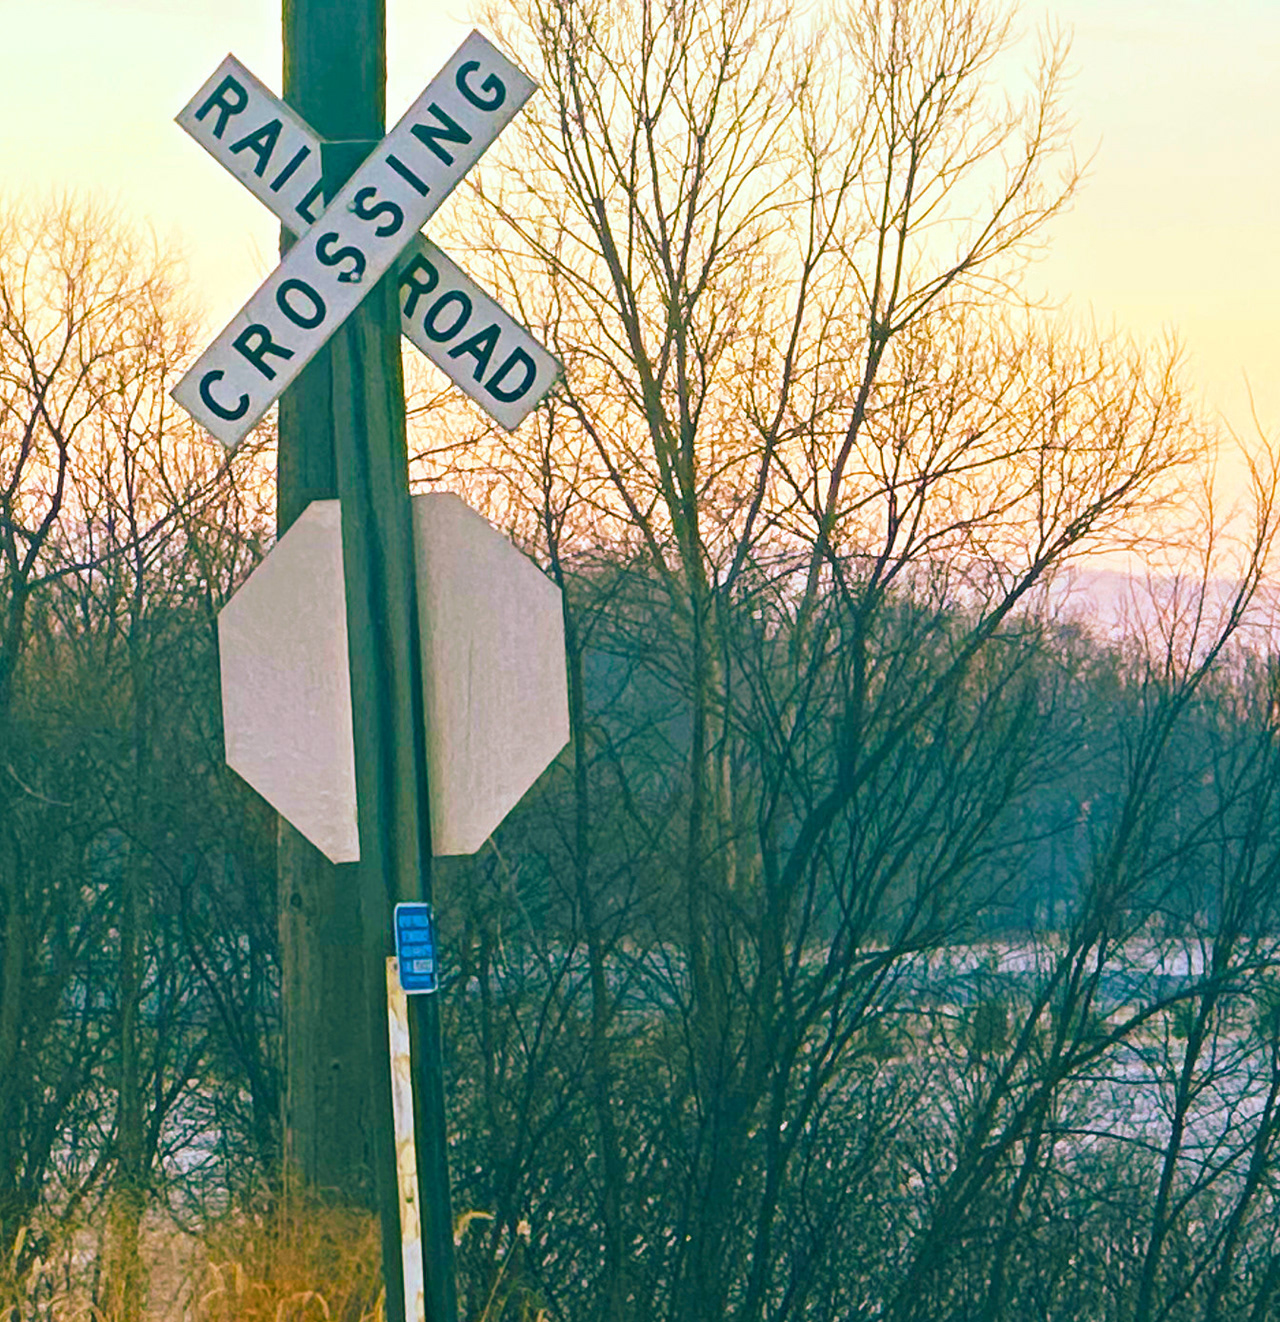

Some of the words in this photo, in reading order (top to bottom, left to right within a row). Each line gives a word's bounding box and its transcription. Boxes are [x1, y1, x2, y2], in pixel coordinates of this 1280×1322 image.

[194, 73, 326, 226] RAIL
[398, 251, 538, 404] ROAD
[198, 60, 508, 422] CROSSING
